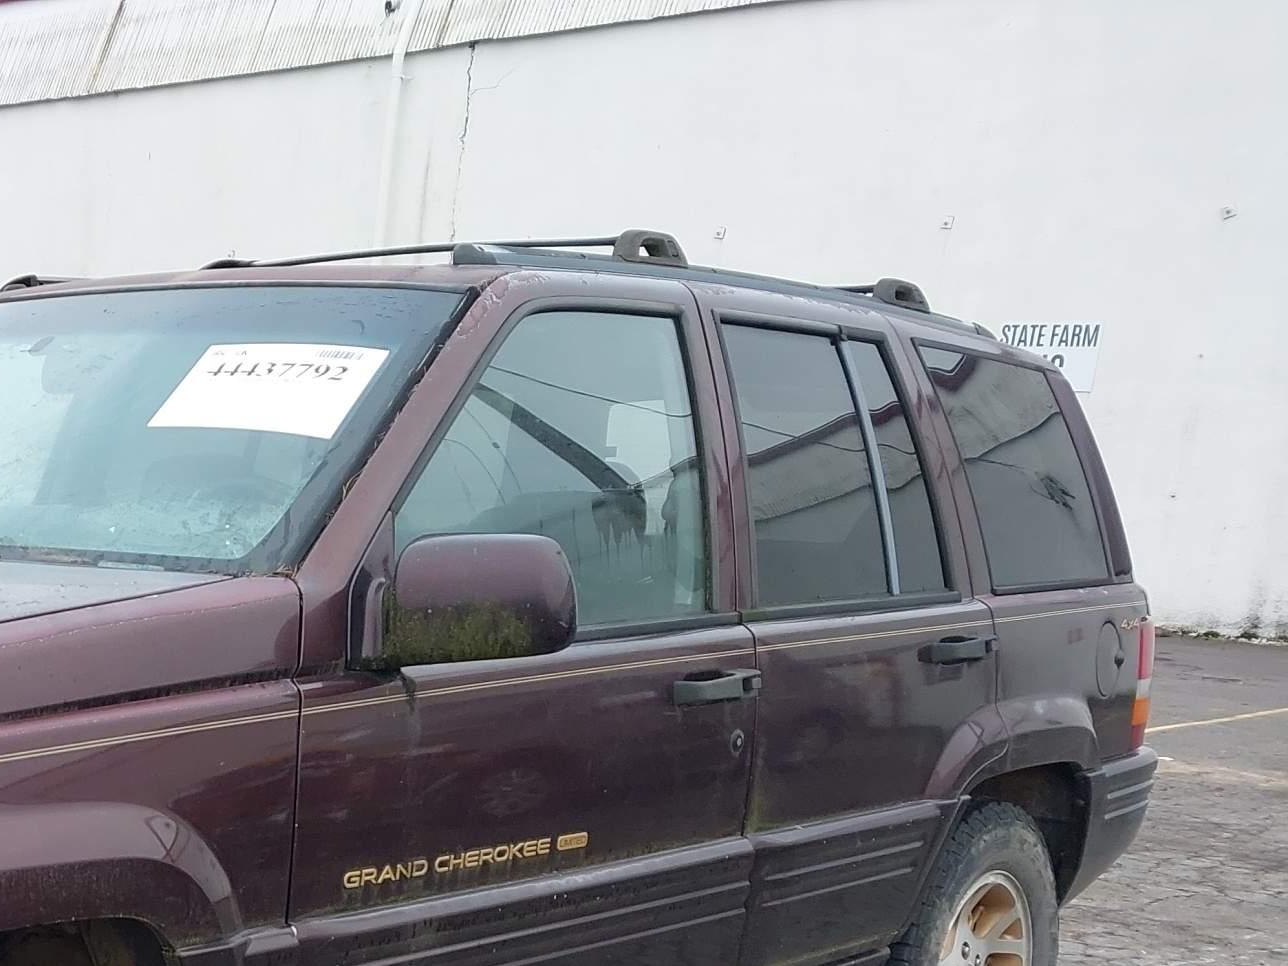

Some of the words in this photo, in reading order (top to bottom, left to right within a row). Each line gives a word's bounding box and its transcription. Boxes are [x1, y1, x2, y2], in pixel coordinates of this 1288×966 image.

[1000, 324, 1048, 347] STATE
[1049, 324, 1100, 347] FARM
[343, 859, 429, 889] GRAND
[433, 837, 552, 874] CHEROKEE
